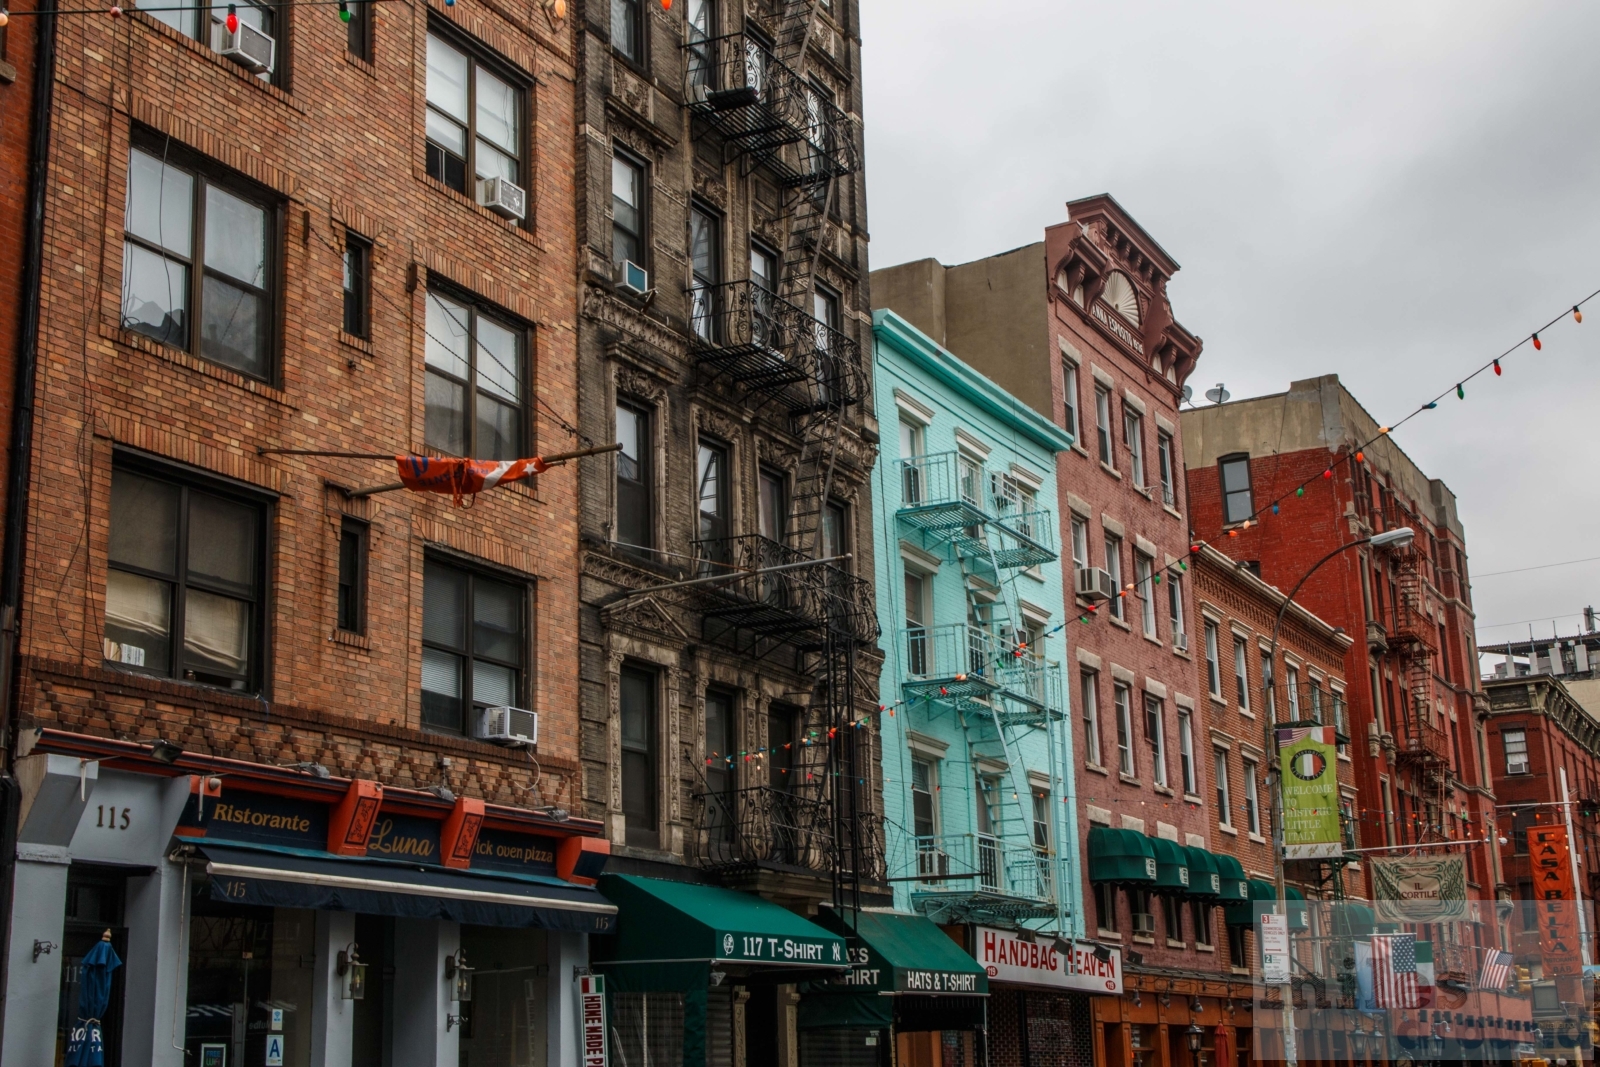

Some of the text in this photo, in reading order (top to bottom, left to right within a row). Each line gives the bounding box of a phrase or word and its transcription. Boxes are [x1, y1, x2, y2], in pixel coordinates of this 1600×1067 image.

[1284, 784, 1334, 796] WELCOME
[1285, 798, 1297, 807] TO
[97, 805, 131, 830] 115
[213, 803, 310, 832] Ristorante
[1286, 806, 1332, 818] HISTORIC
[1287, 820, 1322, 830] LITTLE
[368, 819, 435, 857] Luna
[1288, 830, 1316, 842] ITALY
[473, 838, 554, 864] ick oven pizza
[1537, 832, 1560, 881] CASA
[226, 881, 246, 898] 115
[1414, 882, 1422, 890] IL
[1401, 890, 1438, 898] CORTILE
[595, 916, 609, 930] 115
[1263, 915, 1268, 923] 3
[1545, 890, 1568, 953] BELLA
[742, 936, 763, 958] 117
[767, 938, 824, 960] T-SHIRT
[984, 931, 1058, 971] HANDBAG
[1266, 955, 1270, 963] 2
[65, 965, 84, 984] 11
[987, 968, 996, 976] 119
[908, 970, 976, 991] HATS & T-SHIRT
[1107, 982, 1115, 990] 119
[206, 1050, 221, 1058] FREE
[268, 1038, 280, 1058] A
